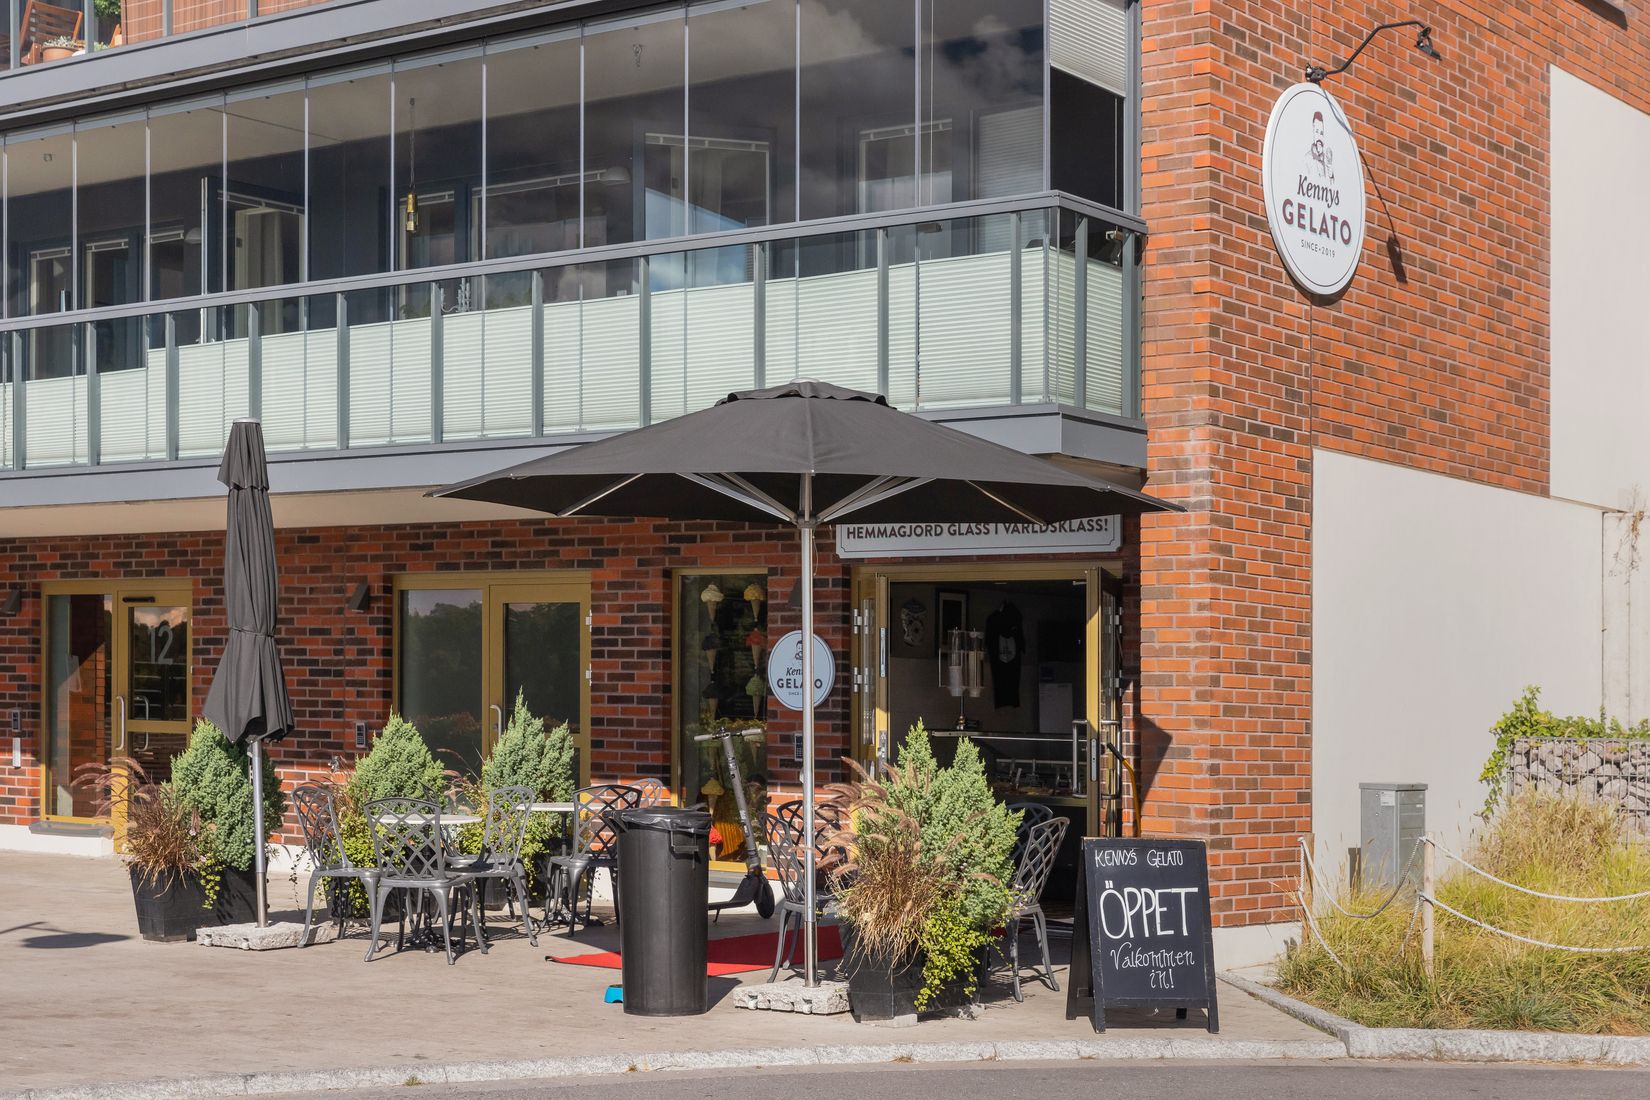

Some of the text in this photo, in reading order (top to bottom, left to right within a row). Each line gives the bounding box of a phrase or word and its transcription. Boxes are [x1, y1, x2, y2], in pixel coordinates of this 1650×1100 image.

[1297, 174, 1340, 208] Kennys
[1282, 199, 1351, 245] GELATO
[847, 524, 943, 539] HEMMAGJORD
[947, 523, 990, 536] GLASS
[148, 626, 173, 664] 12
[776, 678, 823, 689] GELO
[1147, 849, 1184, 868] GELATO
[1100, 880, 1199, 939] ÖPPET
[1110, 942, 1195, 970] Välkommen
[1150, 969, 1175, 989] in!
